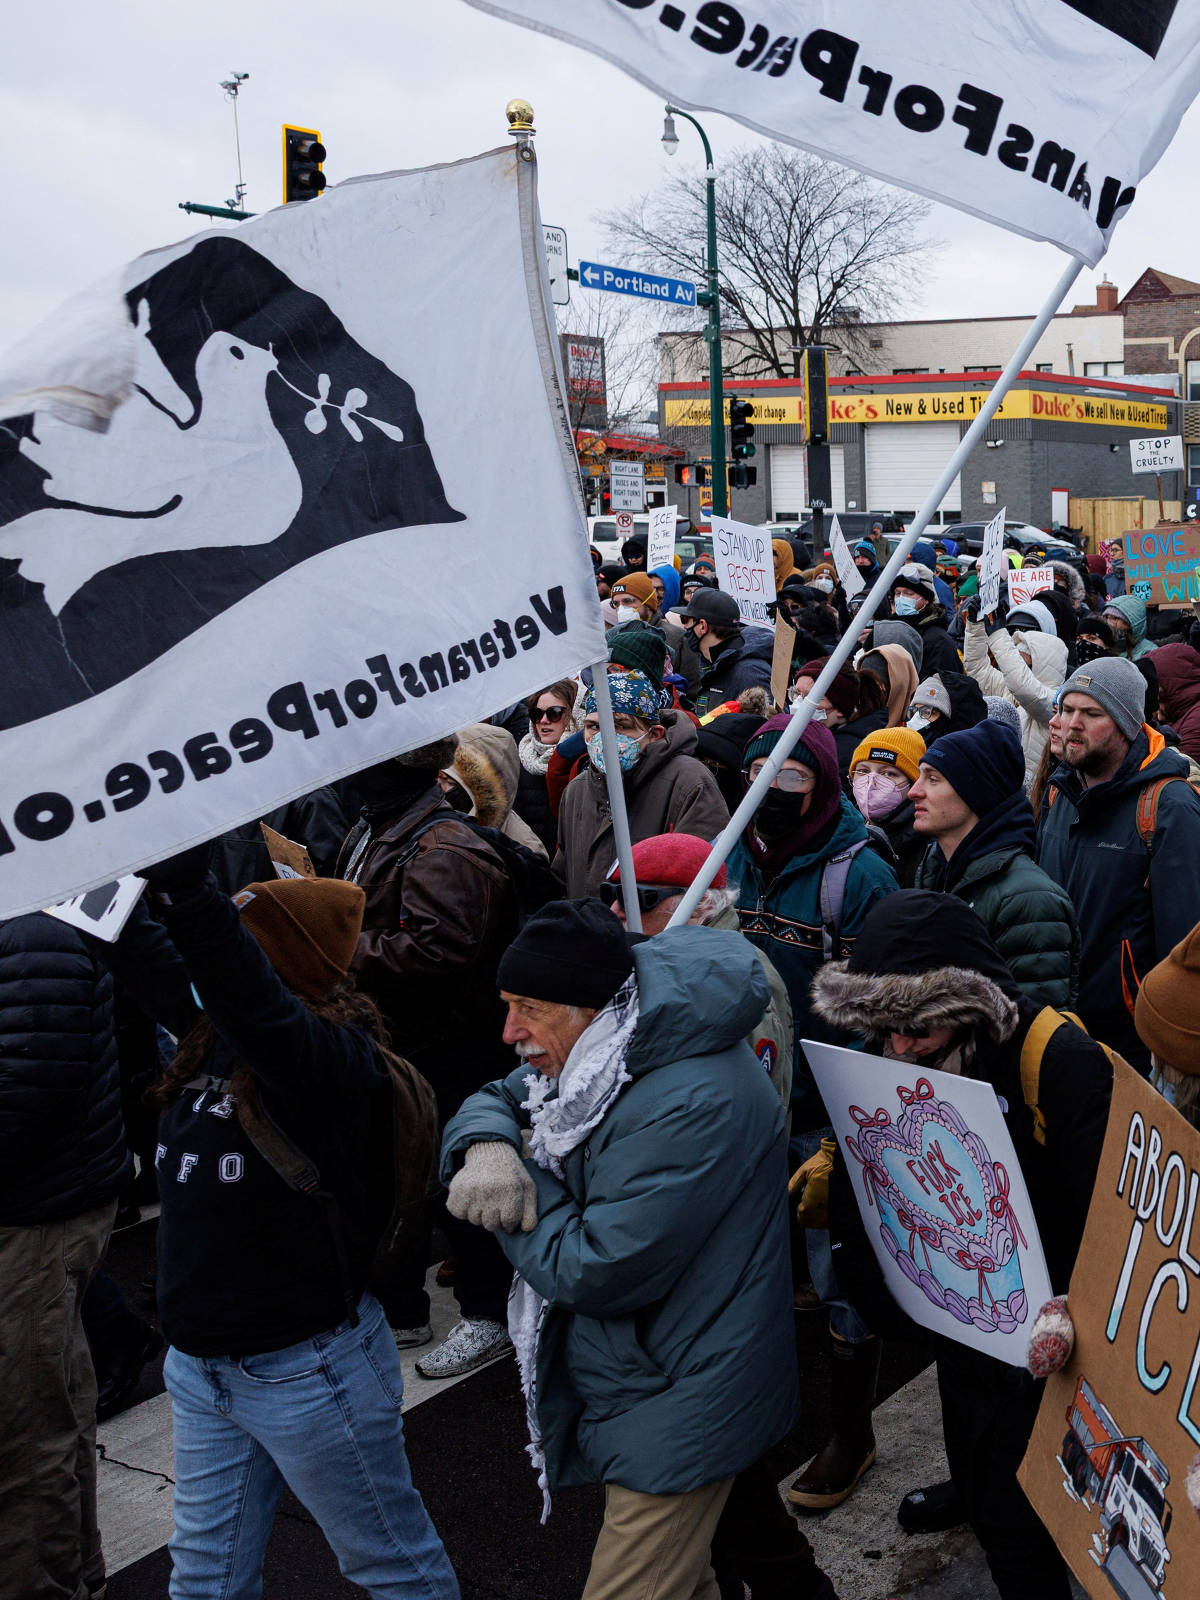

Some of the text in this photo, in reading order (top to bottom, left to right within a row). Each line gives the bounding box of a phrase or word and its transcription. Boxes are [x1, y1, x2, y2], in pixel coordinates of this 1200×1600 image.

[546, 232, 561, 242] AND
[545, 244, 562, 256] URNS
[604, 271, 693, 302] Portland Av
[754, 405, 786, 421] Oil change
[798, 396, 1004, 420] ke's New & Used Tis
[1032, 393, 1084, 419] Duke's
[1084, 401, 1094, 418] We
[1096, 402, 1108, 420] sell
[1110, 404, 1125, 421] New
[1150, 408, 1167, 425] Tires
[1138, 439, 1170, 450] STOP
[1136, 456, 1174, 467] CRUELTY
[628, 466, 639, 474] LANE
[630, 480, 639, 488] AND
[653, 512, 672, 528] ICE
[1125, 530, 1186, 560] LOVE
[1011, 570, 1051, 583] WE ARE
[1126, 562, 1161, 579] WILL
[1129, 583, 1153, 594] FUCK
[906, 1139, 961, 1195] FUCK
[939, 1184, 983, 1227] ICE
